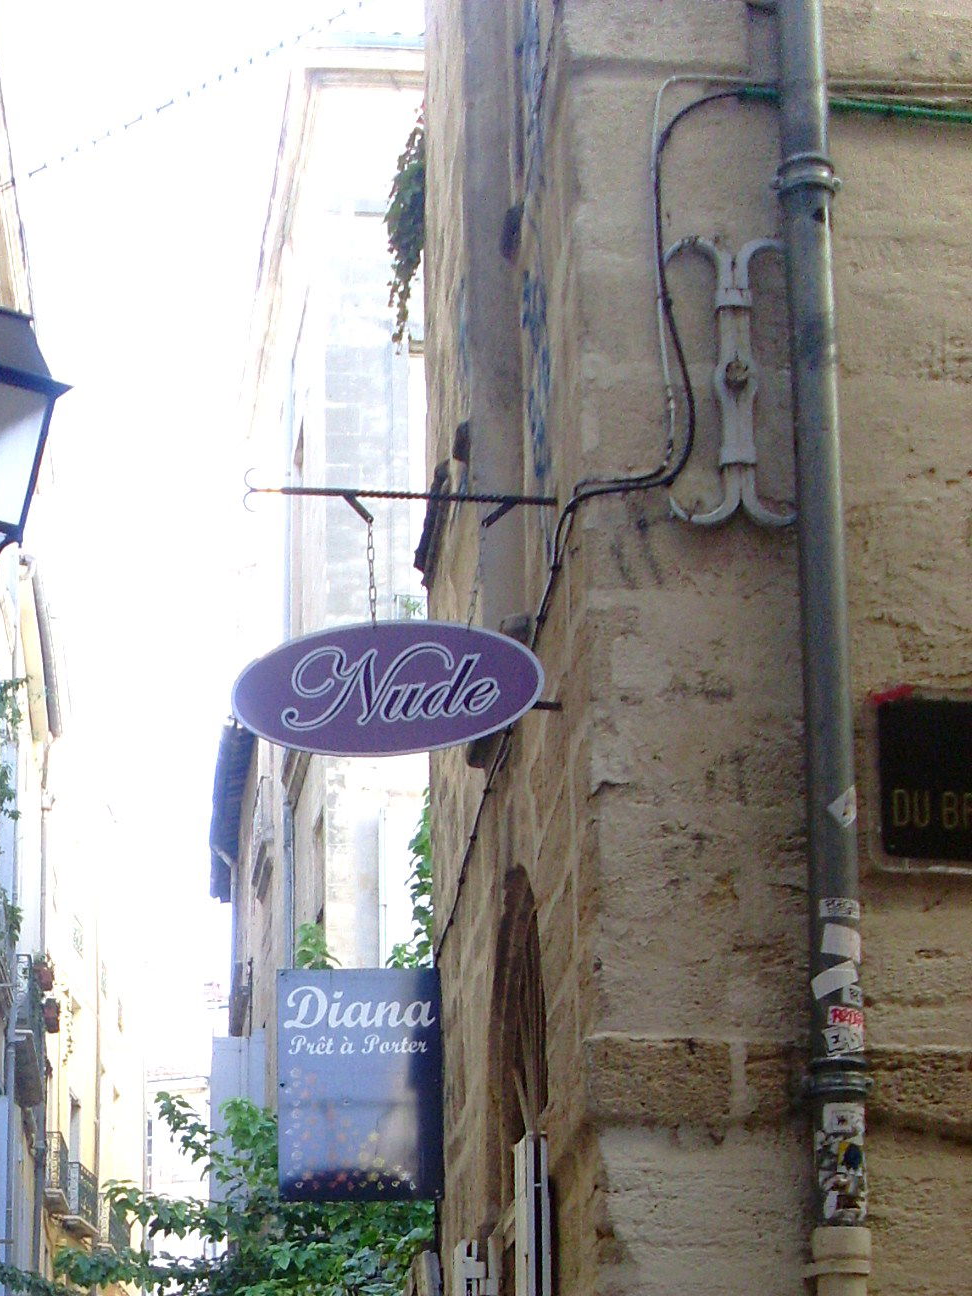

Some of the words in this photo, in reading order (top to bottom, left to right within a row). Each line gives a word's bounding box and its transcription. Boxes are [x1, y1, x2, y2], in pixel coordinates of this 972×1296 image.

[281, 642, 500, 731] Nude
[892, 789, 930, 827] DU
[284, 986, 436, 1029] Diana
[288, 1035, 334, 1055] Prêt
[340, 1036, 355, 1055] à
[362, 1034, 427, 1053] Porter
